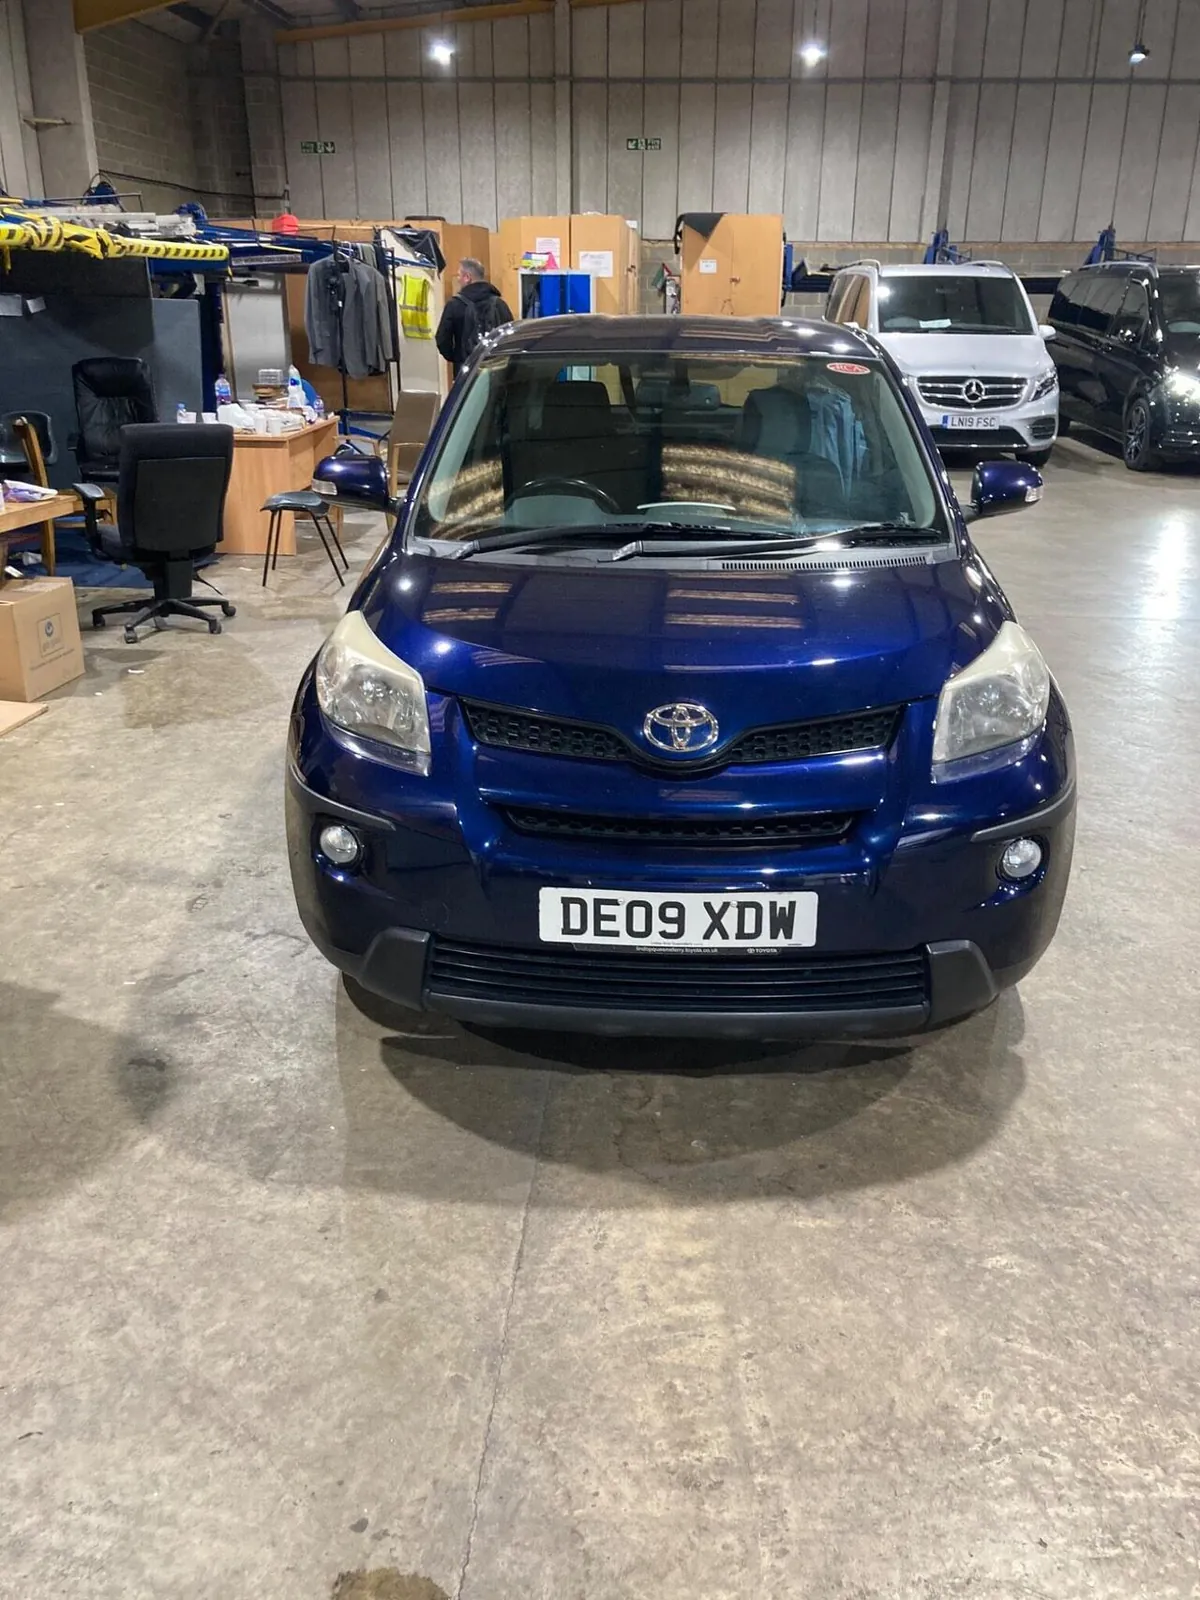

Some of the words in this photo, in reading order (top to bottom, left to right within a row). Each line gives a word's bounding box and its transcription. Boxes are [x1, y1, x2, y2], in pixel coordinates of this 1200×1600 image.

[951, 417, 974, 427] LN19
[976, 417, 996, 427] FSC
[561, 896, 685, 940] DE09
[702, 900, 797, 940] XDW
